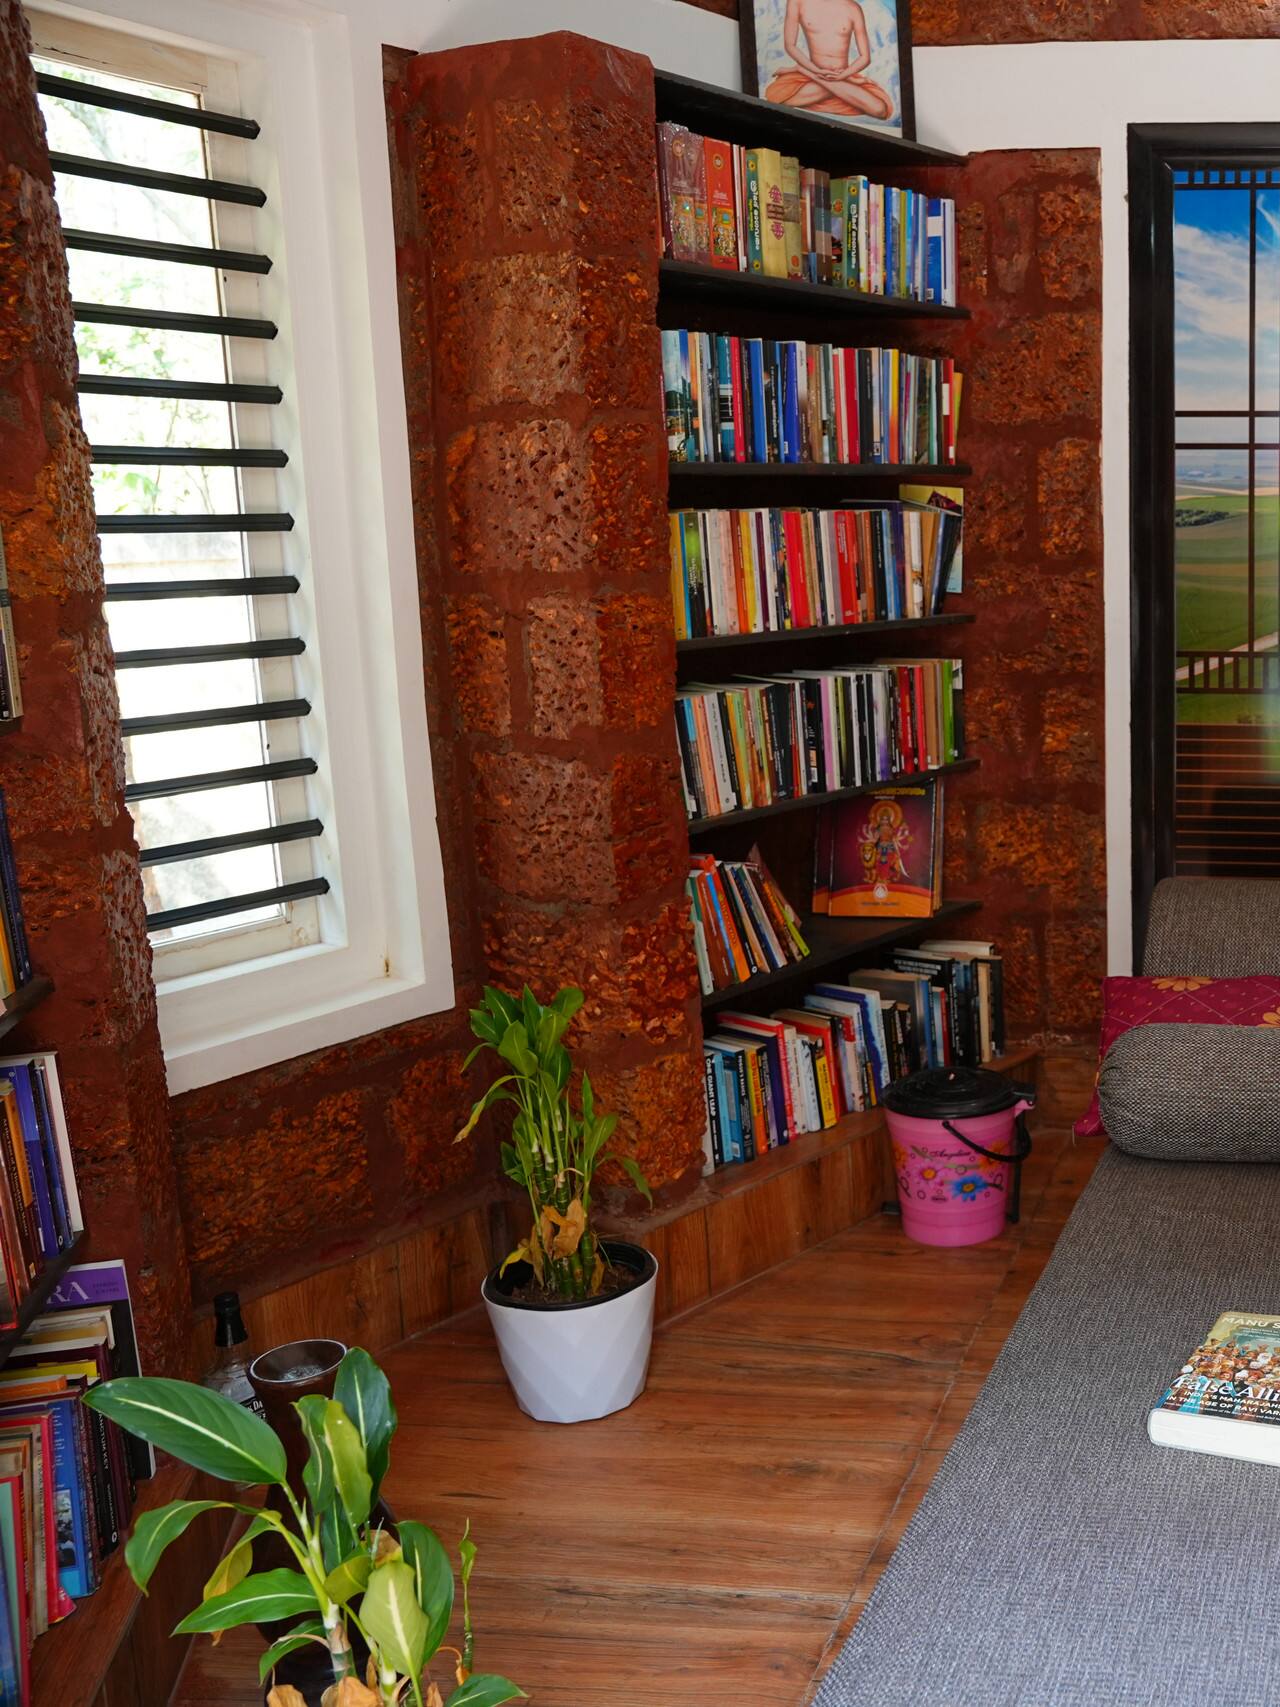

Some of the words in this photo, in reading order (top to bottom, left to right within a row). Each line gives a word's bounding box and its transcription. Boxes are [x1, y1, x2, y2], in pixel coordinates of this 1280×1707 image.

[704, 1057, 713, 1074] ONE
[705, 1074, 716, 1099] GIANT
[708, 1099, 716, 1116] LEAP
[1222, 1317, 1269, 1328] MANU
[1173, 1377, 1233, 1395] False
[1184, 1391, 1215, 1401] INDIA'S
[1198, 1399, 1217, 1408] AGE
[1236, 1404, 1258, 1414] RAVI
